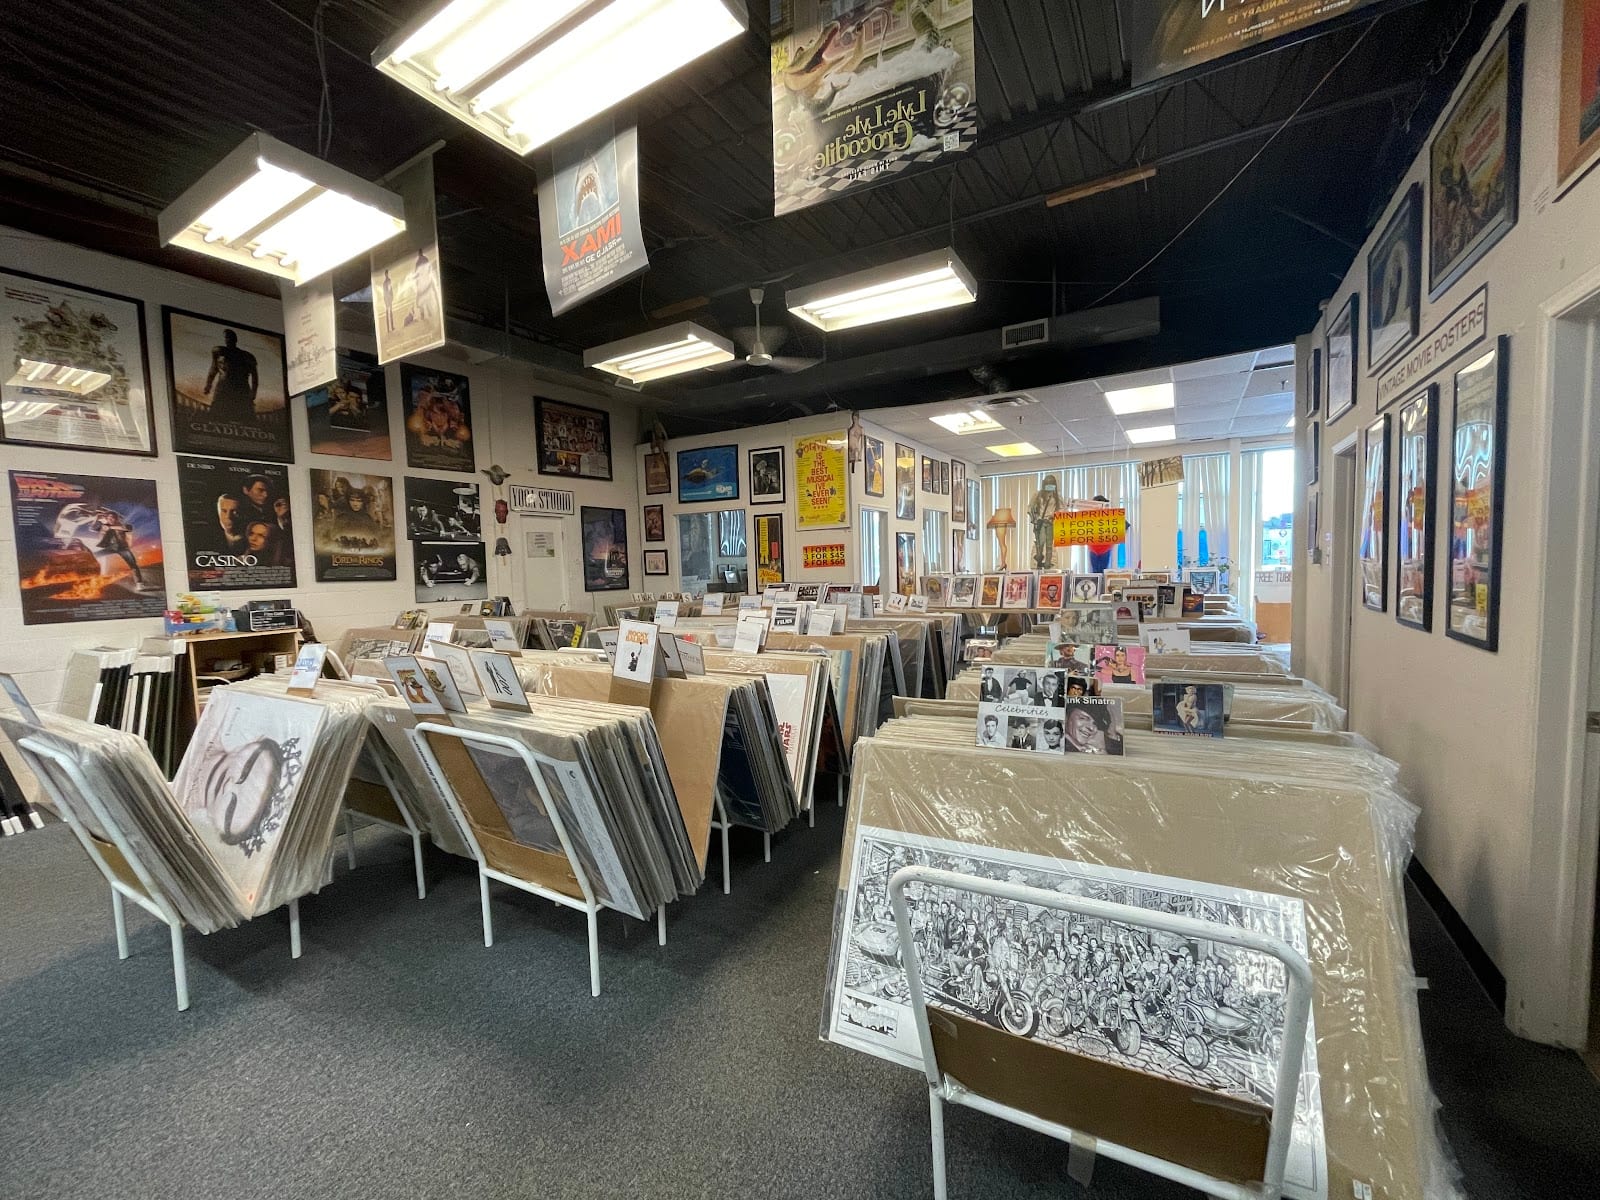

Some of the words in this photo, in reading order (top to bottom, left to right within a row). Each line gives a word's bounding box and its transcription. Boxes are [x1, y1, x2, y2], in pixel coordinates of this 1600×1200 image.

[1380, 366, 1406, 397] VINTAGE
[1406, 345, 1433, 377] MOVIE
[1434, 303, 1484, 358] POSTERS
[190, 422, 275, 440] GLADIATOR
[811, 466, 828, 475] BEST
[807, 474, 833, 484] MUSICAL
[812, 489, 829, 497] EVER
[538, 490, 571, 511] STUDIO
[1053, 512, 1077, 520] MINI
[1081, 508, 1125, 519] PRINTS
[1070, 520, 1094, 529] FOR
[1098, 518, 1119, 527] $15
[1070, 528, 1094, 537] FOR
[1098, 526, 1119, 535] $40
[1060, 537, 1066, 545] 5
[1070, 536, 1094, 545] FOR
[1098, 535, 1119, 543] $50
[332, 554, 353, 566] LORD
[359, 554, 384, 566] RINGS
[830, 551, 845, 559] $45
[195, 555, 258, 567] CASINO
[811, 559, 828, 567] FOR
[830, 558, 846, 566] $60
[1255, 571, 1274, 583] FREE
[1082, 696, 1115, 705] Sinatra
[995, 704, 1049, 716] Celebrities
